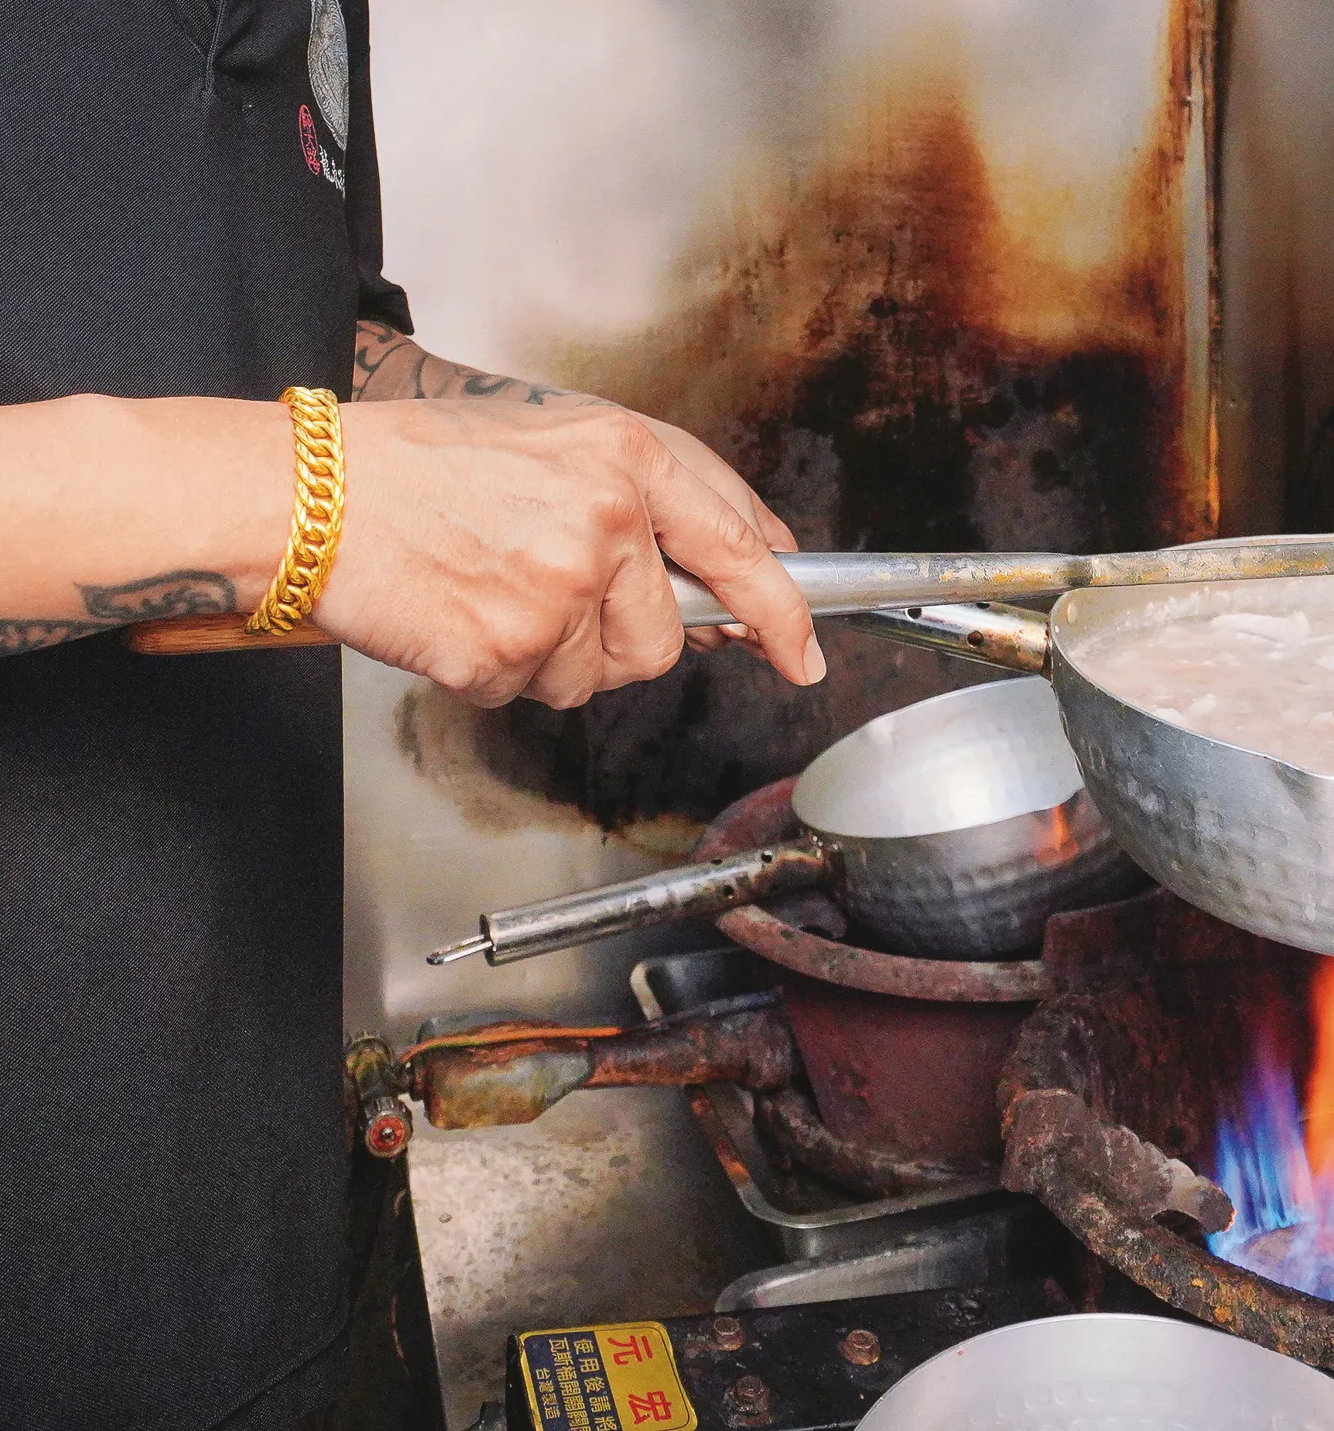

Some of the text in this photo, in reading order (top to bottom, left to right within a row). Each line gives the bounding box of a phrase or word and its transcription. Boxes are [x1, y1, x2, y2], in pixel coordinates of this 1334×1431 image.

[536, 1368, 561, 1420] 台灣製造
[607, 1336, 672, 1425] 元宏
